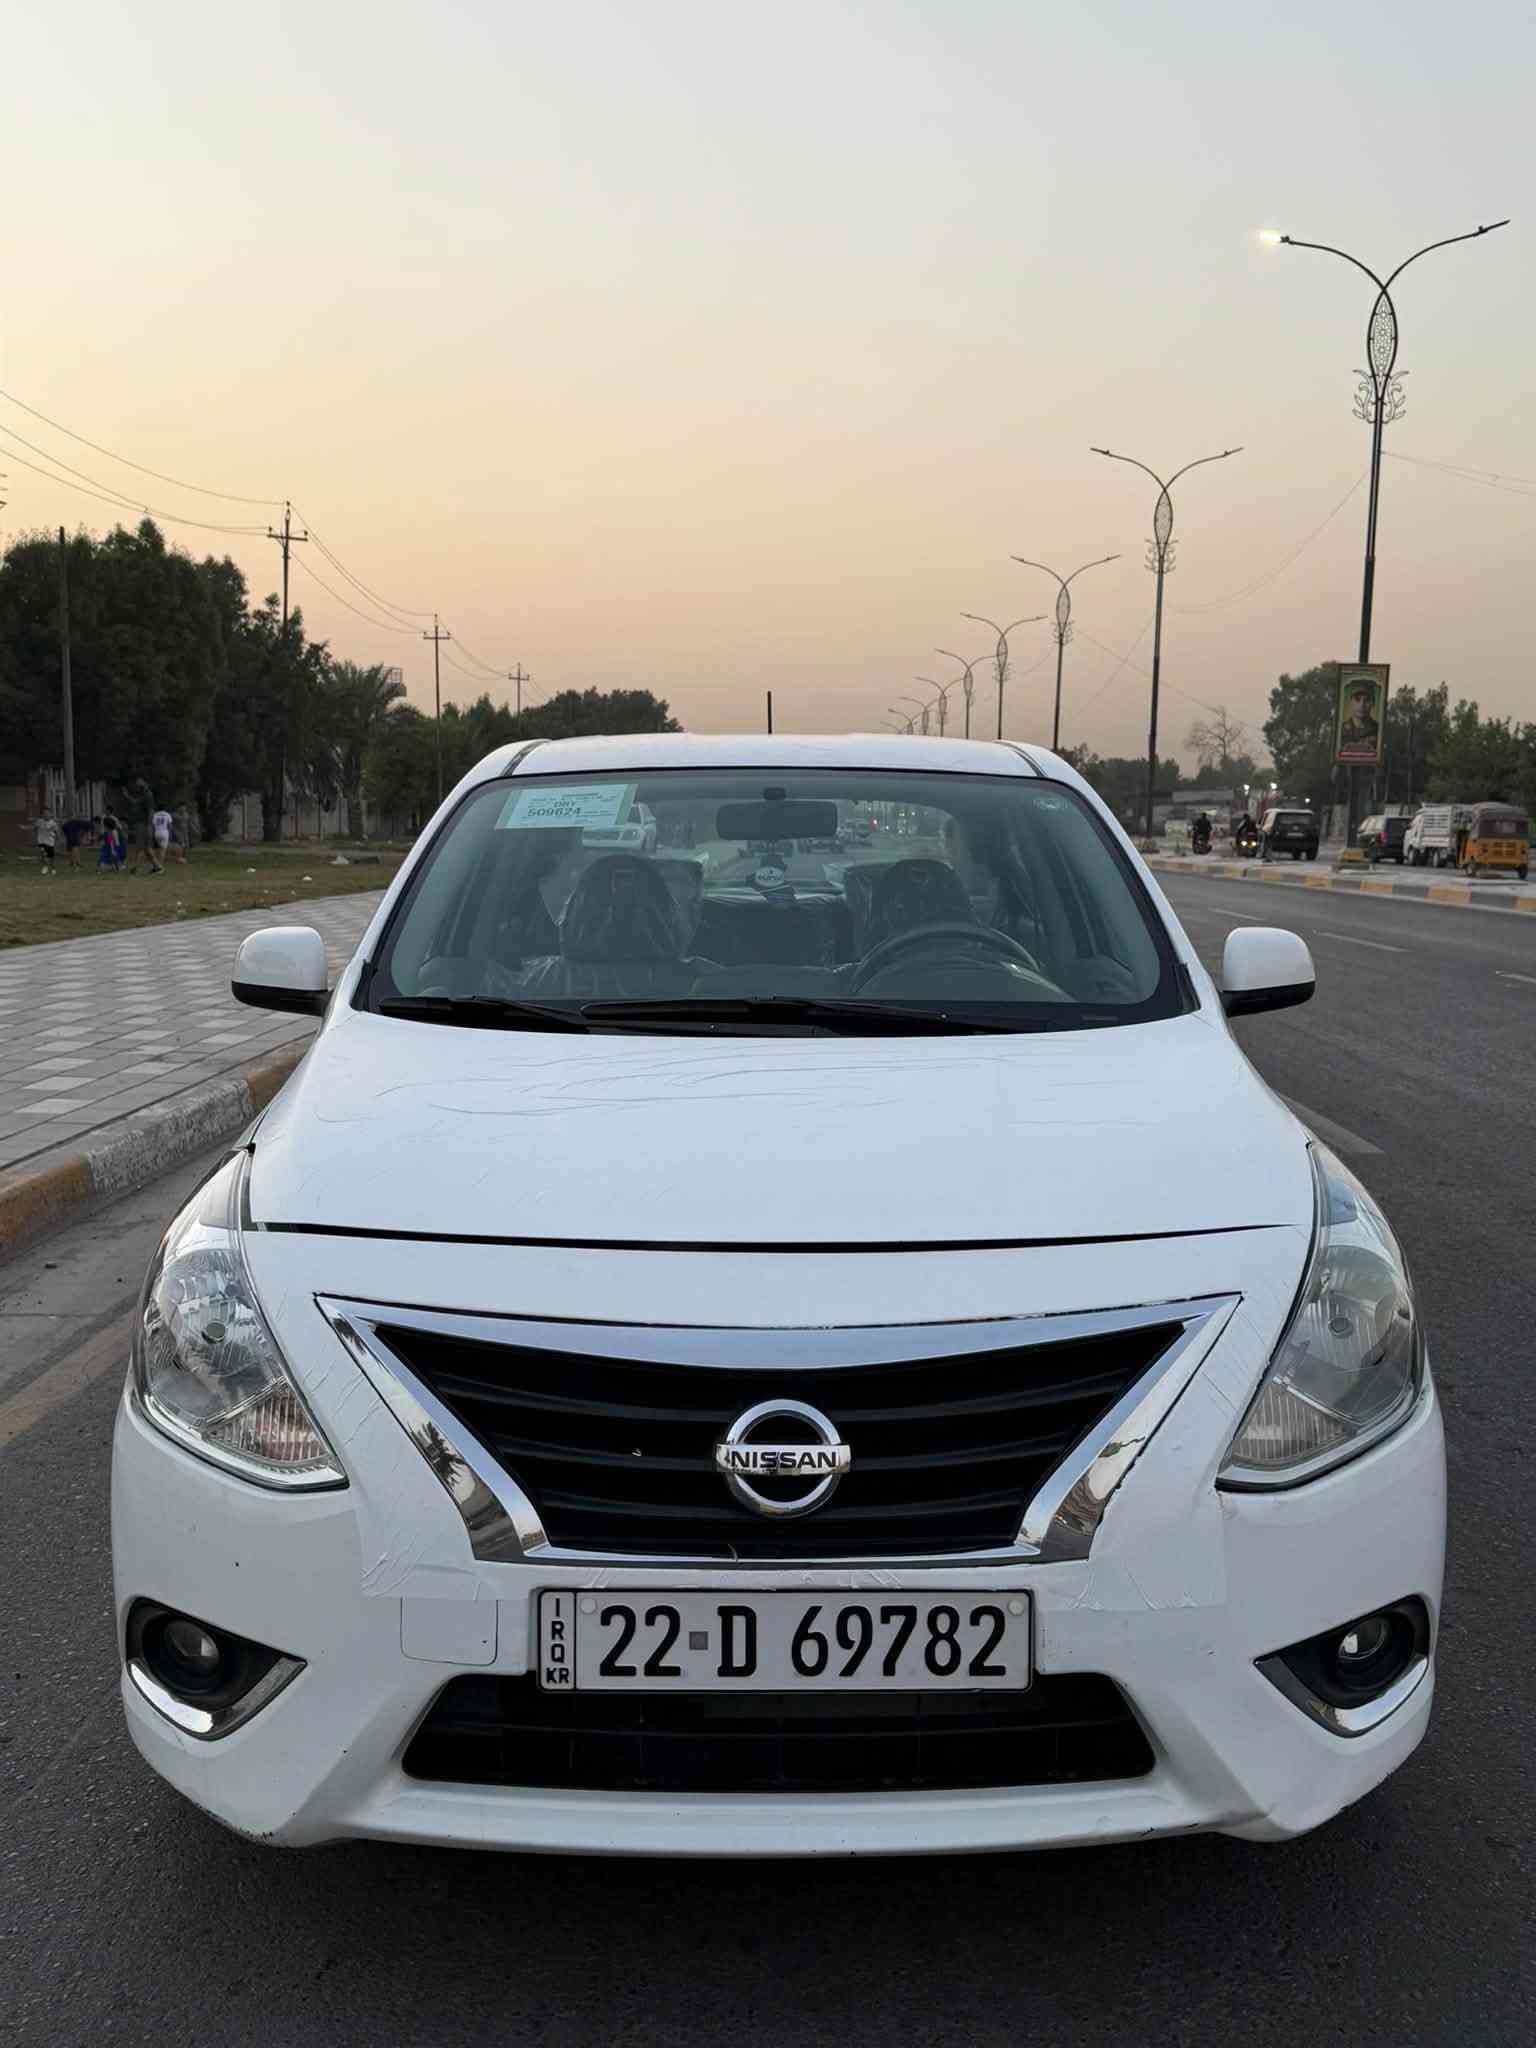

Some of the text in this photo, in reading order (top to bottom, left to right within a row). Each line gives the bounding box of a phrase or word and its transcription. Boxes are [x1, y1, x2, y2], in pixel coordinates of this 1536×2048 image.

[730, 1450, 837, 1469] NISSAN
[551, 1598, 565, 1664] IRQ
[599, 1604, 1008, 1677] 22 D 69782
[545, 1667, 570, 1684] KR
